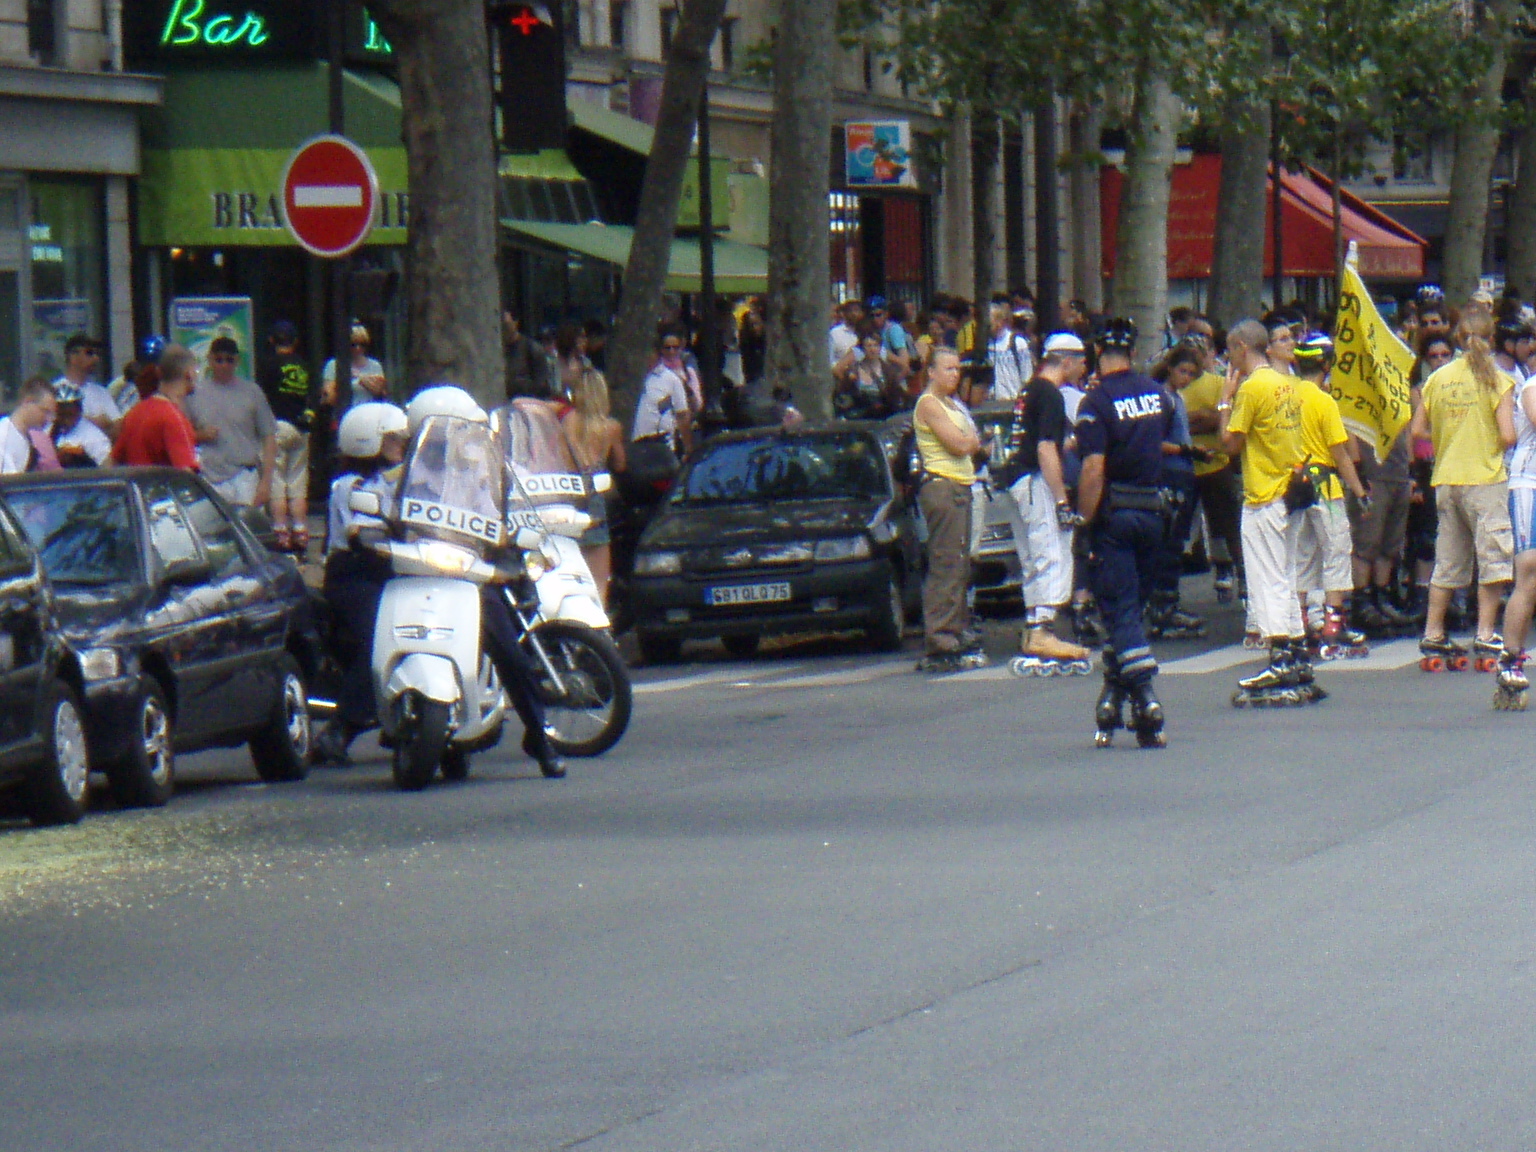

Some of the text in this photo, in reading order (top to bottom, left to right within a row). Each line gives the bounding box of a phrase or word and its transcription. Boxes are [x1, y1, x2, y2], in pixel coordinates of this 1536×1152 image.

[162, 0, 270, 45] Bar
[1114, 394, 1162, 421] POLICE
[524, 477, 583, 492] OLICE
[407, 502, 499, 539] POLICE
